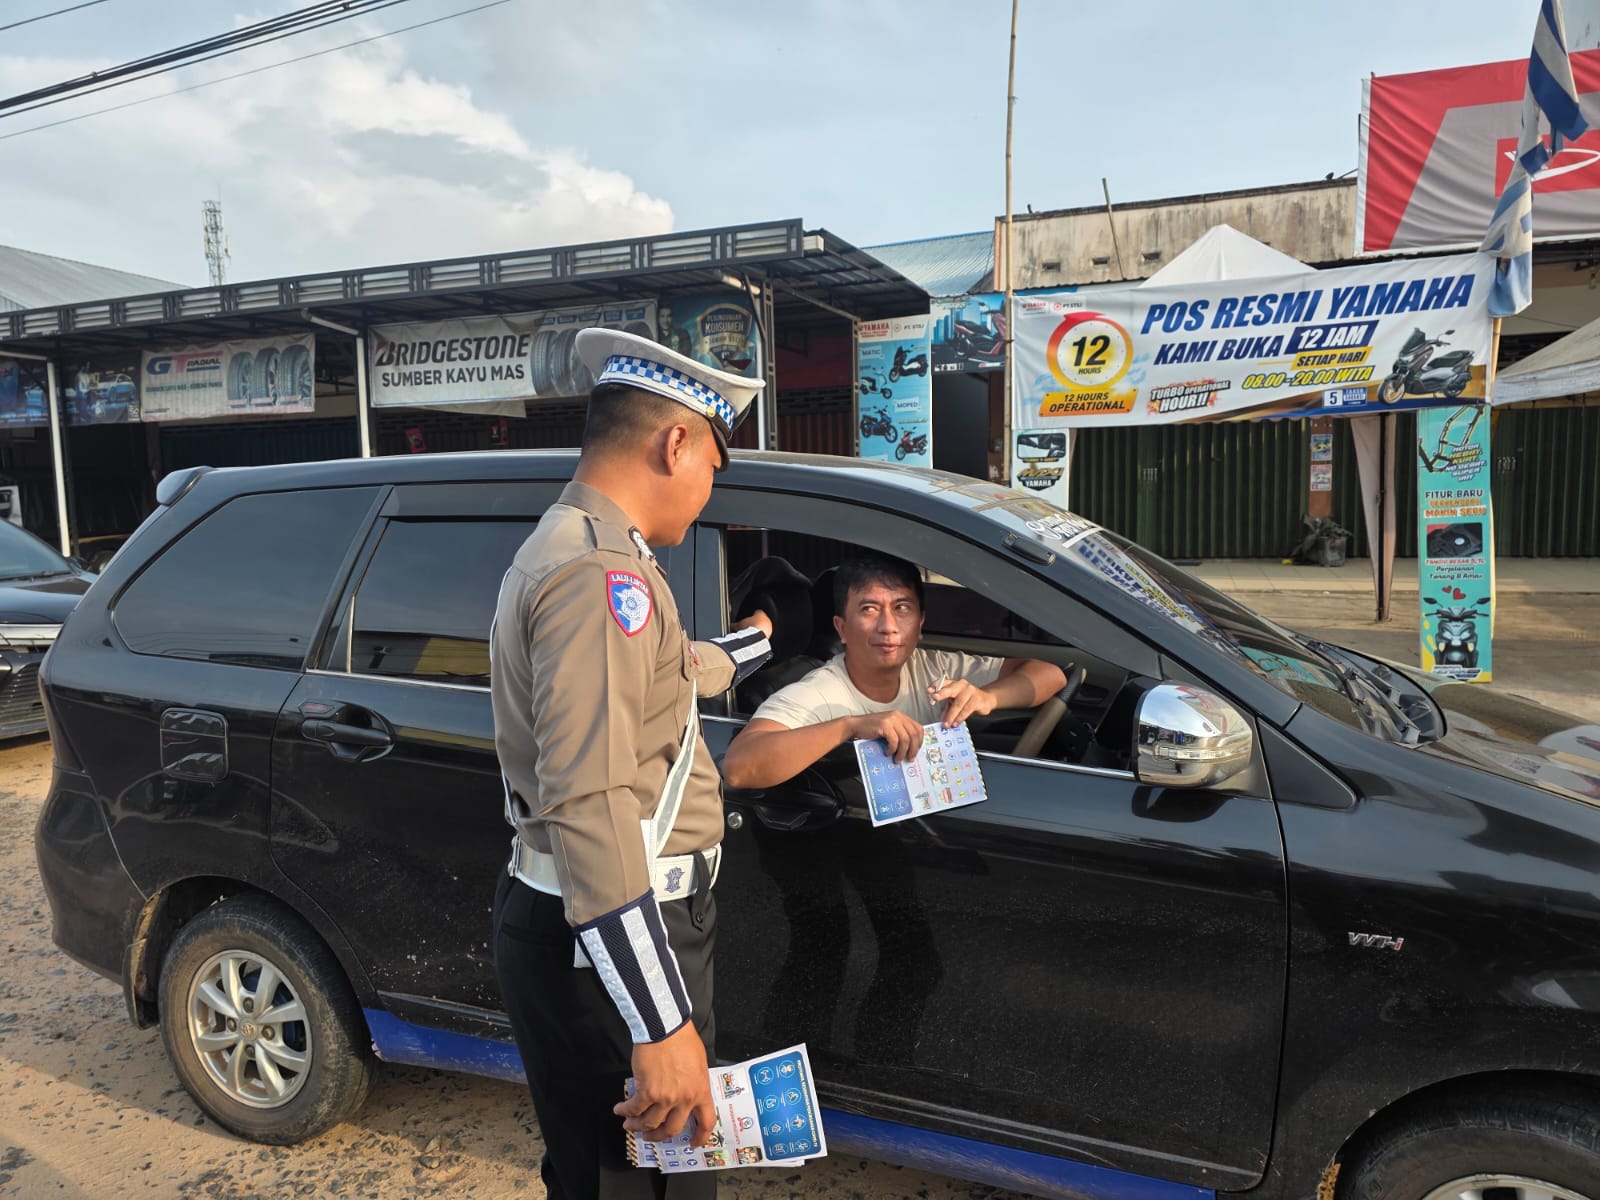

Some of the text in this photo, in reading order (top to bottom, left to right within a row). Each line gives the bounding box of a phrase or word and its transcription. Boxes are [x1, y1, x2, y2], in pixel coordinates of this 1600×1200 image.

[1140, 274, 1475, 335] POS RESMI YAMAHA
[859, 323, 890, 331] YAMAHA
[375, 333, 530, 367] BRIDGESTONE
[1072, 335, 1111, 366] 12
[1153, 324, 1368, 365] KAMI BUKA 12 JAM
[186, 358, 221, 367] RADIAL
[1296, 351, 1367, 367] SETIAP HARI
[382, 364, 525, 388] SUMBER KAYU MAS
[1078, 367, 1102, 375] HOURS
[1242, 372, 1287, 389] 08.00
[1292, 369, 1336, 386] 20.00
[1333, 365, 1375, 384] WITA
[1064, 392, 1109, 402] 12 HOURS
[1151, 381, 1230, 401] TURBO OPERATIONAL
[1329, 392, 1338, 405] 5
[1049, 401, 1125, 413] OPERATIONAL
[1160, 392, 1210, 413] HOUR!!
[1025, 479, 1052, 487] YAMAHA
[1456, 489, 1483, 497] BARU
[1424, 507, 1487, 517] MAKIN SERU
[1347, 931, 1405, 951] VVT-i
